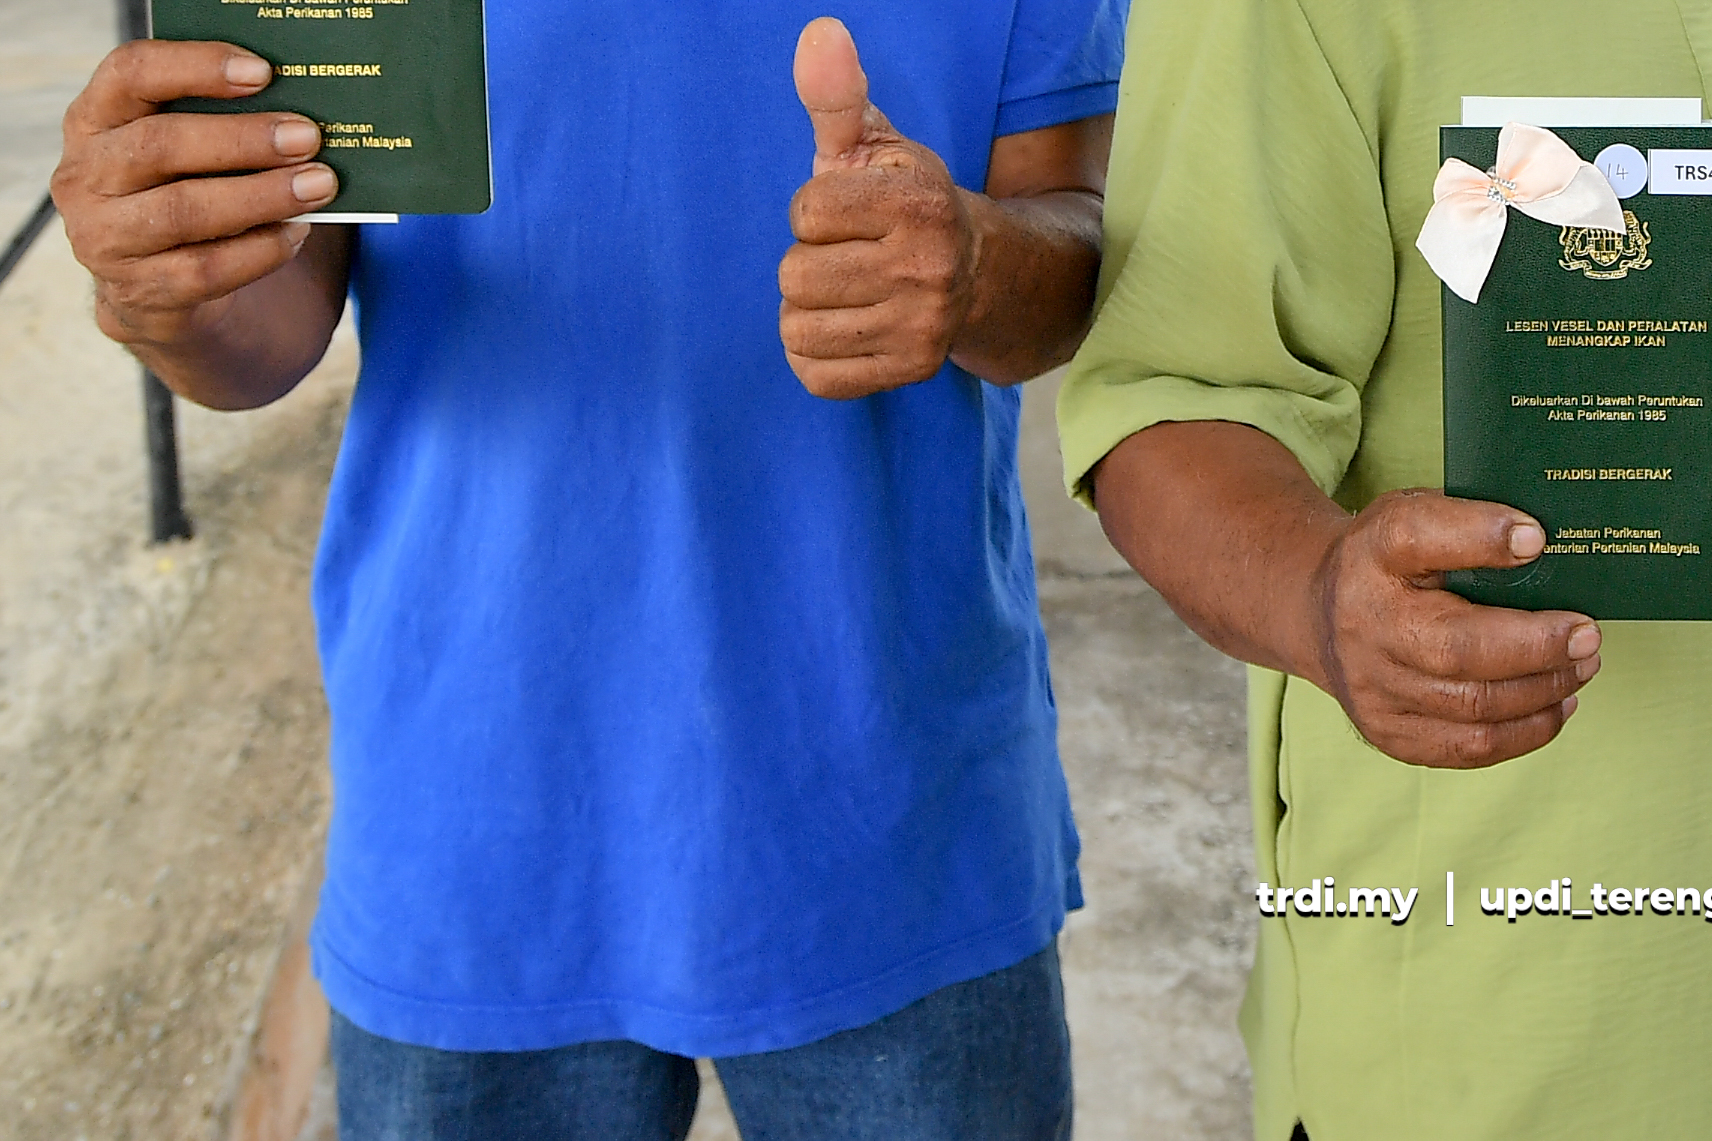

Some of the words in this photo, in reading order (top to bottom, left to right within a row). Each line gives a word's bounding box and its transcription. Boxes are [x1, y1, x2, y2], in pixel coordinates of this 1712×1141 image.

[257, 7, 283, 18] Akta
[286, 7, 342, 18] Perikanan
[345, 7, 373, 19] 1985
[273, 65, 307, 77] ADISI
[309, 64, 382, 77] BERGERAK
[362, 136, 412, 151] Malaysia
[1606, 162, 1629, 180] 14
[1505, 320, 1548, 332] LESEN
[1551, 320, 1594, 332] VESEL
[1597, 320, 1625, 332] DAN
[1628, 320, 1708, 332] PERALATAN
[1547, 335, 1631, 346] MENANGKAP
[1634, 335, 1666, 346] IKAN
[1511, 395, 1578, 406] Dikeluarkan
[1581, 395, 1594, 406] Di
[1597, 395, 1635, 406] bawah
[1637, 395, 1703, 407] Peruntukan
[1547, 409, 1574, 421] Akta
[1577, 409, 1635, 421] Perikanan
[1638, 409, 1667, 421] 1985
[1544, 469, 1596, 480] TRADISI
[1599, 469, 1672, 480] BERGERAK
[1555, 527, 1600, 539] Jabatan
[1604, 527, 1661, 539] Perikanan
[1544, 542, 1589, 554] enterian
[1592, 542, 1646, 554] Pertanian
[1649, 542, 1700, 556] Malaysia
